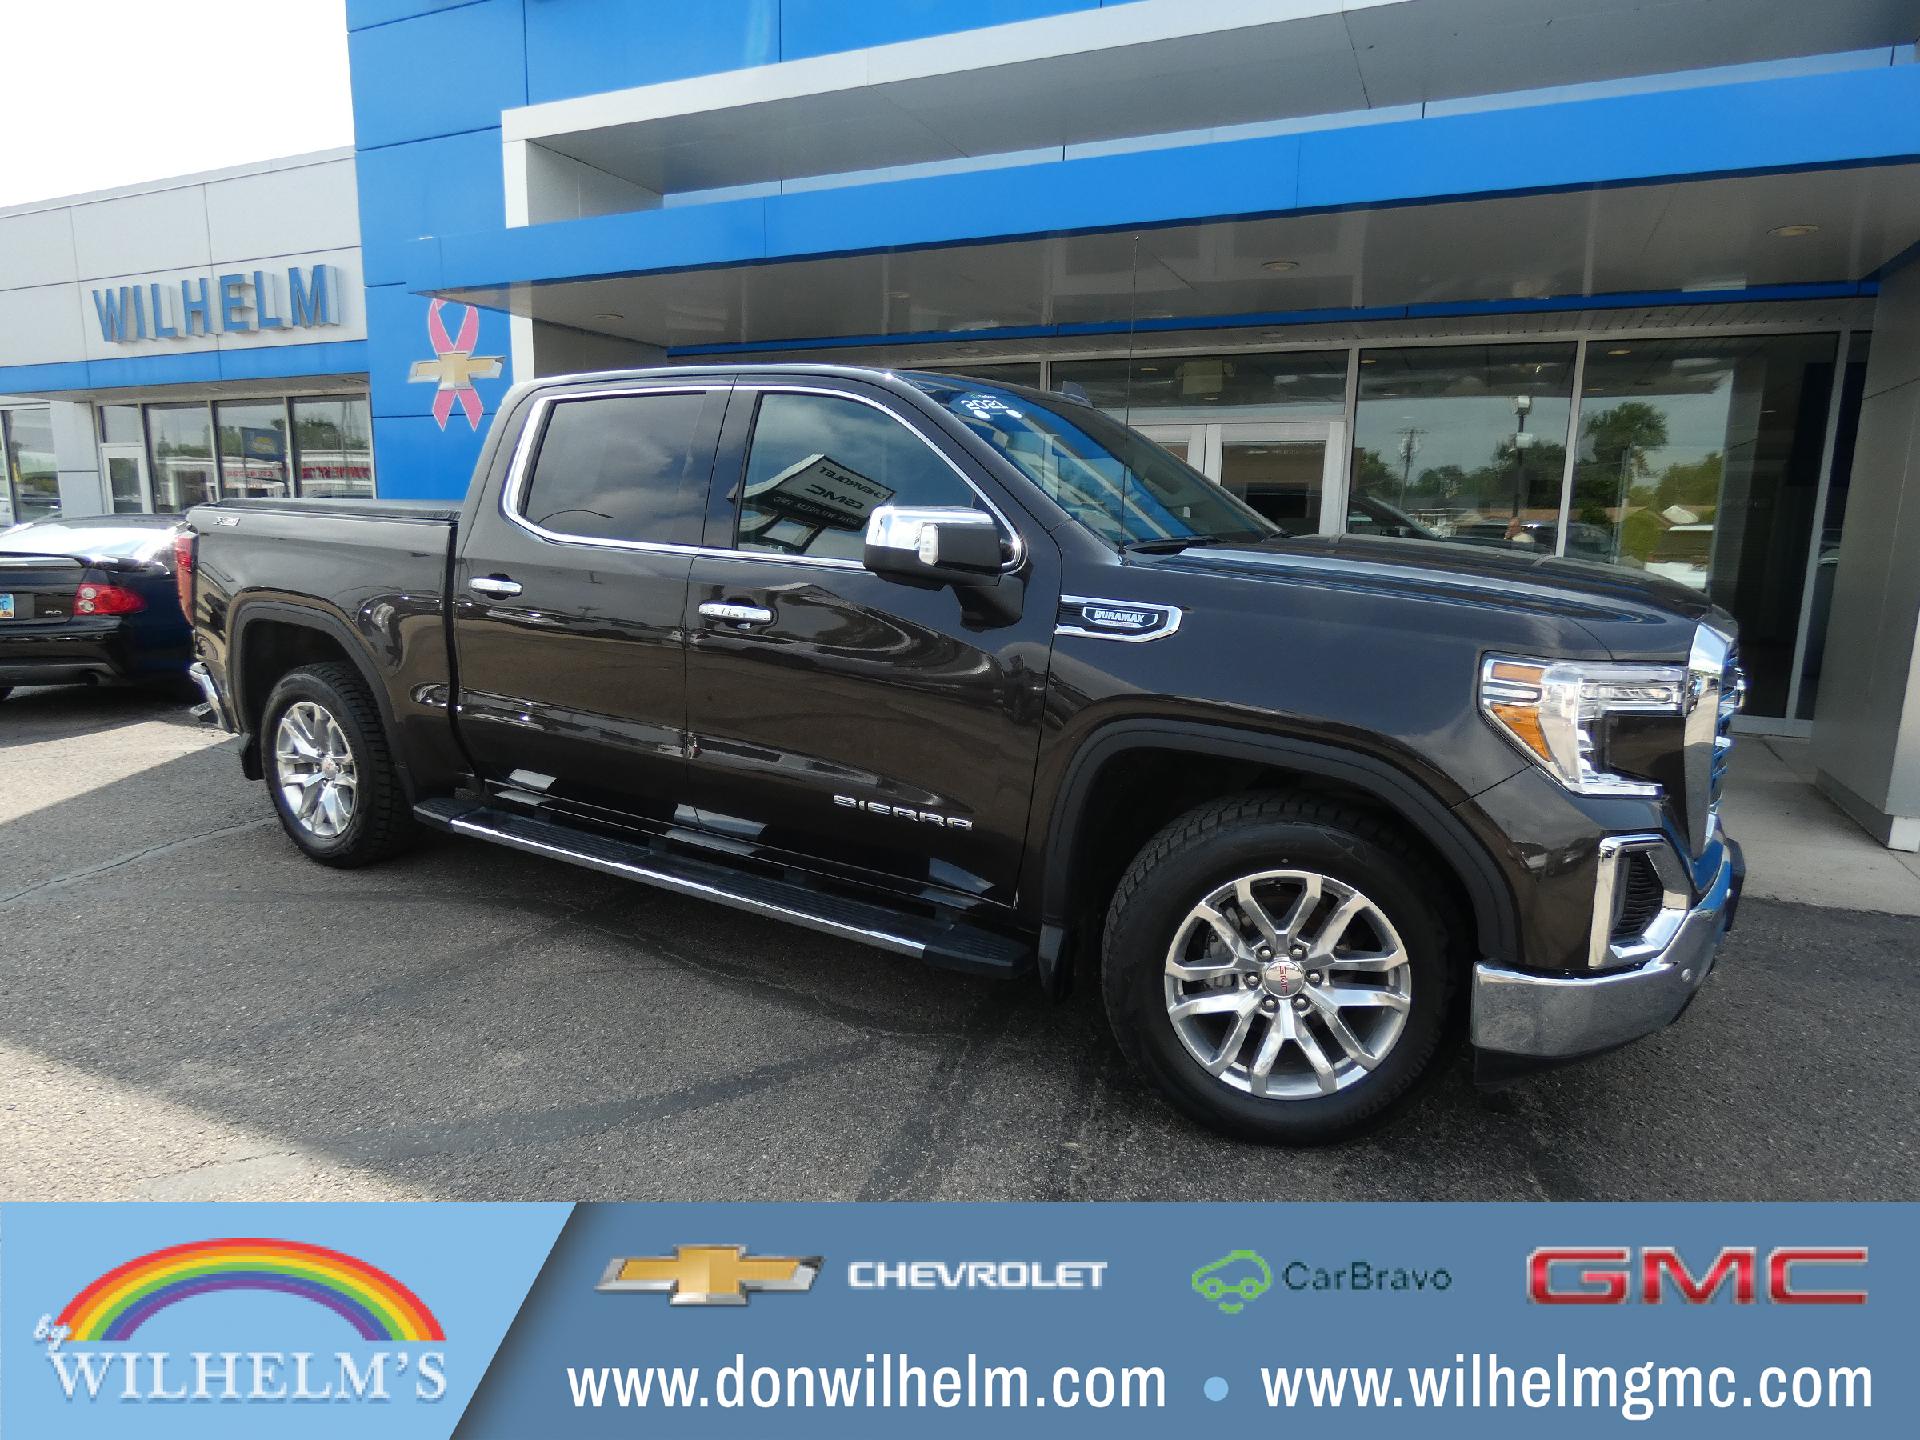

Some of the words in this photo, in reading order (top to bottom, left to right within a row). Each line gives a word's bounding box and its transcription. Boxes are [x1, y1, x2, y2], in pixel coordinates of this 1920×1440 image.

[92, 264, 338, 344] WILHELM
[1094, 609, 1145, 623] DURAMAX
[833, 795, 973, 831] SIERRA
